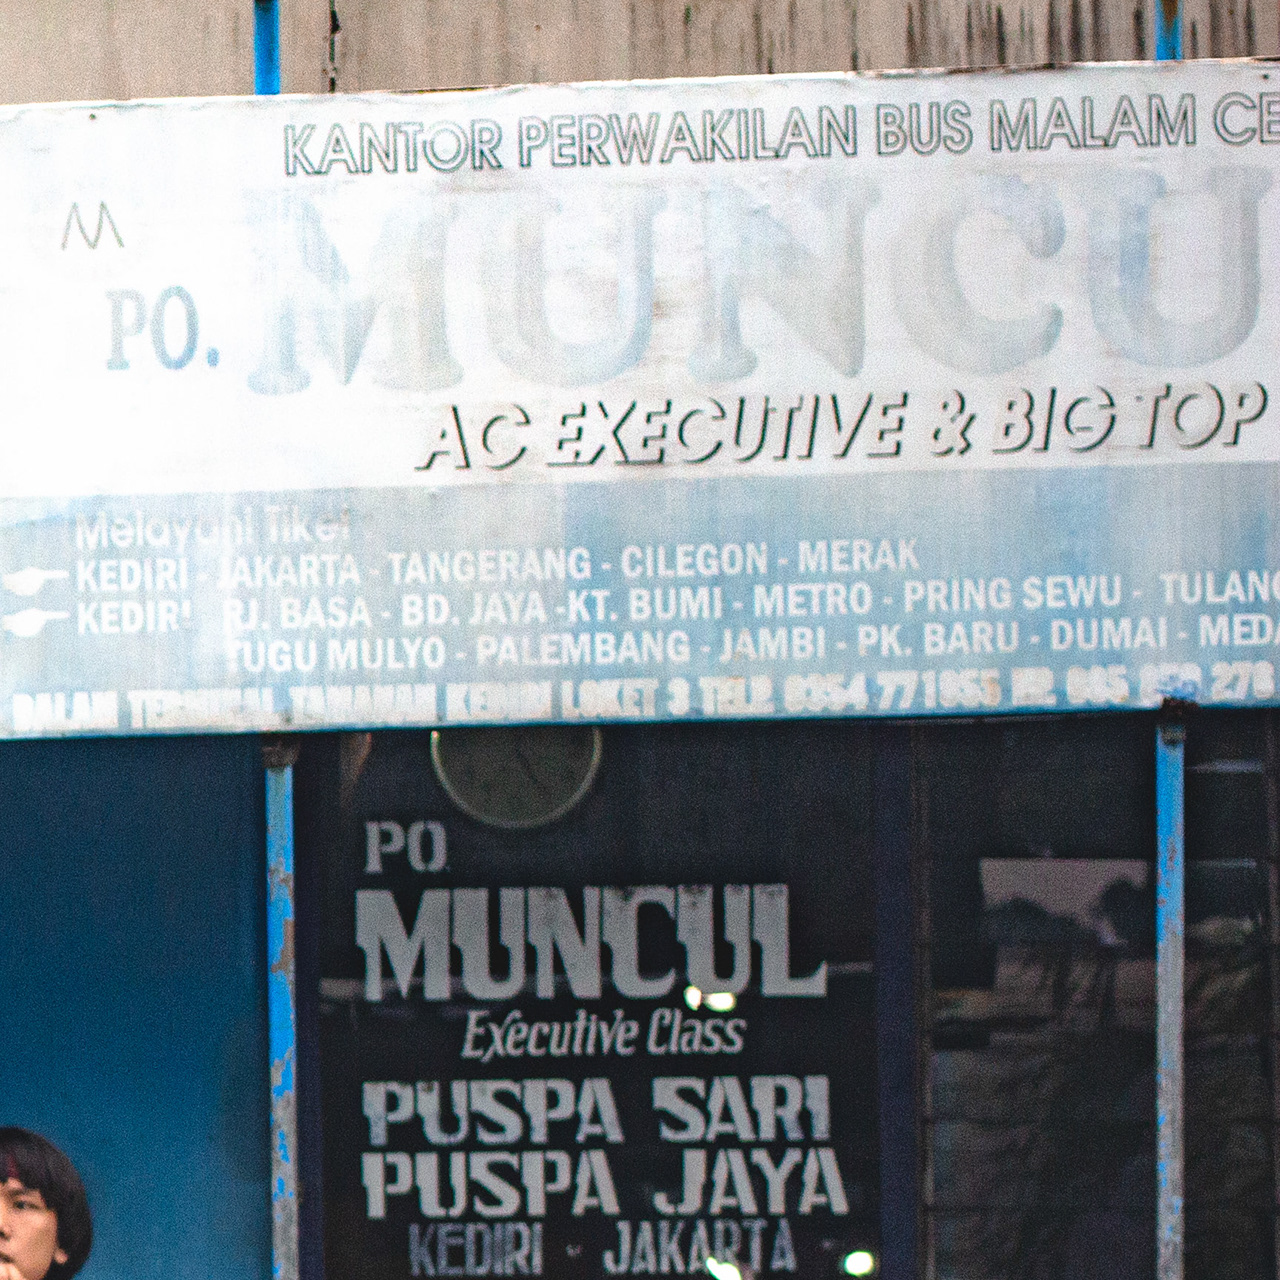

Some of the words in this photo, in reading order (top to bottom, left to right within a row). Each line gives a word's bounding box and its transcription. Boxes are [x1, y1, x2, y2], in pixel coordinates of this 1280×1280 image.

[283, 117, 502, 177] KANTOR
[518, 103, 857, 168] PERWAKILAN
[876, 100, 973, 157] BUS
[990, 94, 1198, 151] MALAM
[106, 286, 219, 370] PO.
[415, 403, 531, 471] AC
[546, 391, 911, 469] EXECUTIVE
[930, 390, 976, 459] &
[993, 386, 1117, 454] BIG
[1137, 382, 1269, 449] TOP
[77, 557, 189, 592] KEDIRI
[218, 553, 362, 589] JAKARTA
[387, 547, 592, 586] TANGERANG
[620, 541, 769, 579] CILEGON
[797, 539, 922, 575] MERAK
[280, 597, 373, 630] BASA
[401, 594, 460, 629] BD.
[469, 591, 549, 625] JAYA
[628, 585, 723, 621] BUMI
[753, 582, 874, 618] METRO
[903, 577, 1012, 614] PRING
[1022, 575, 1123, 610] SEWU
[326, 636, 447, 671] MULYO
[476, 630, 691, 668] PALEMBANG
[718, 626, 826, 663] JAMBI
[858, 622, 910, 658] PK.
[923, 619, 1020, 655] BARU
[1051, 616, 1168, 652] DUMAI
[354, 883, 828, 1002] MUNCUL
[460, 1008, 639, 1063] Executive
[646, 1006, 748, 1056] Class
[361, 1077, 625, 1146] PUSPA
[651, 1074, 832, 1143] SARI
[360, 1149, 621, 1219] PUSPA
[652, 1147, 849, 1217] JAYA
[408, 1221, 543, 1277] KEDIRI
[603, 1218, 797, 1275] JAKARTA
